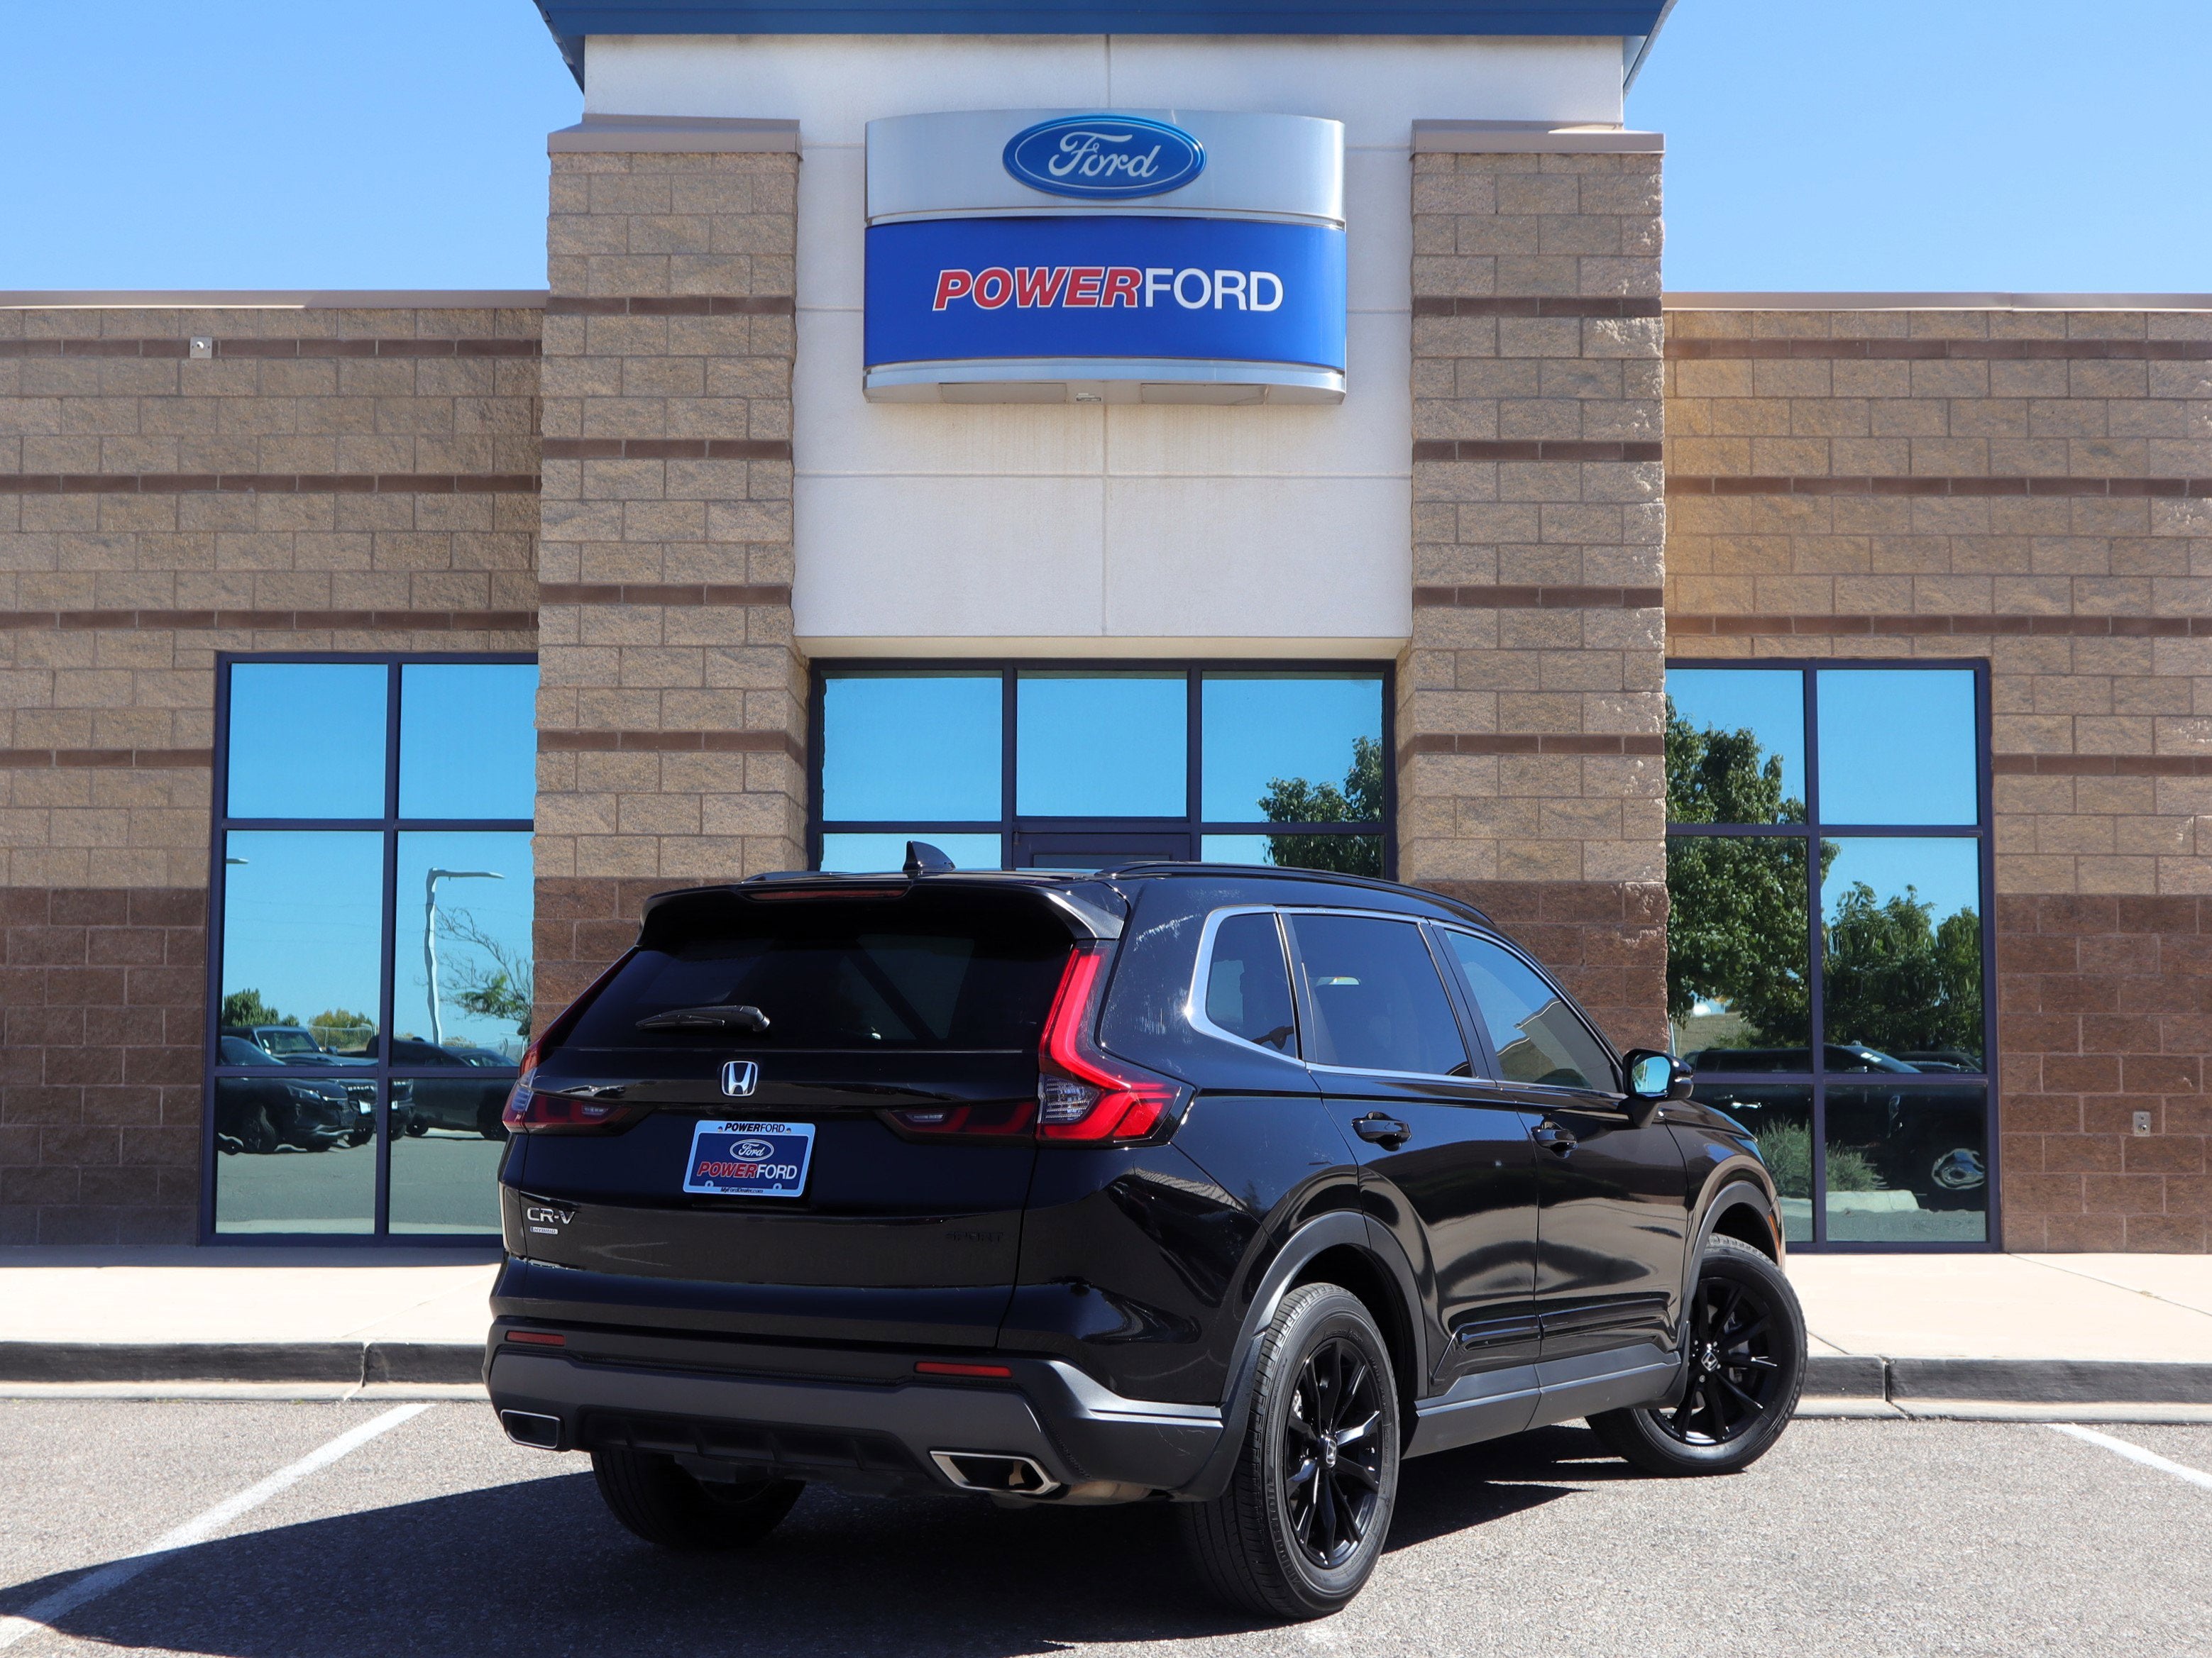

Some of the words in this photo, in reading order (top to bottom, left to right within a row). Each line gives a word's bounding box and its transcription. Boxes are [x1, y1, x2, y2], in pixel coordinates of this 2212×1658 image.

[1048, 132, 1161, 178] Ford
[932, 267, 1284, 311] POWERFORD
[725, 1123, 785, 1133] POWERFORD
[738, 1143, 764, 1156] Ford
[697, 1161, 798, 1180] POWERFORD
[527, 1207, 576, 1225] CR-V
